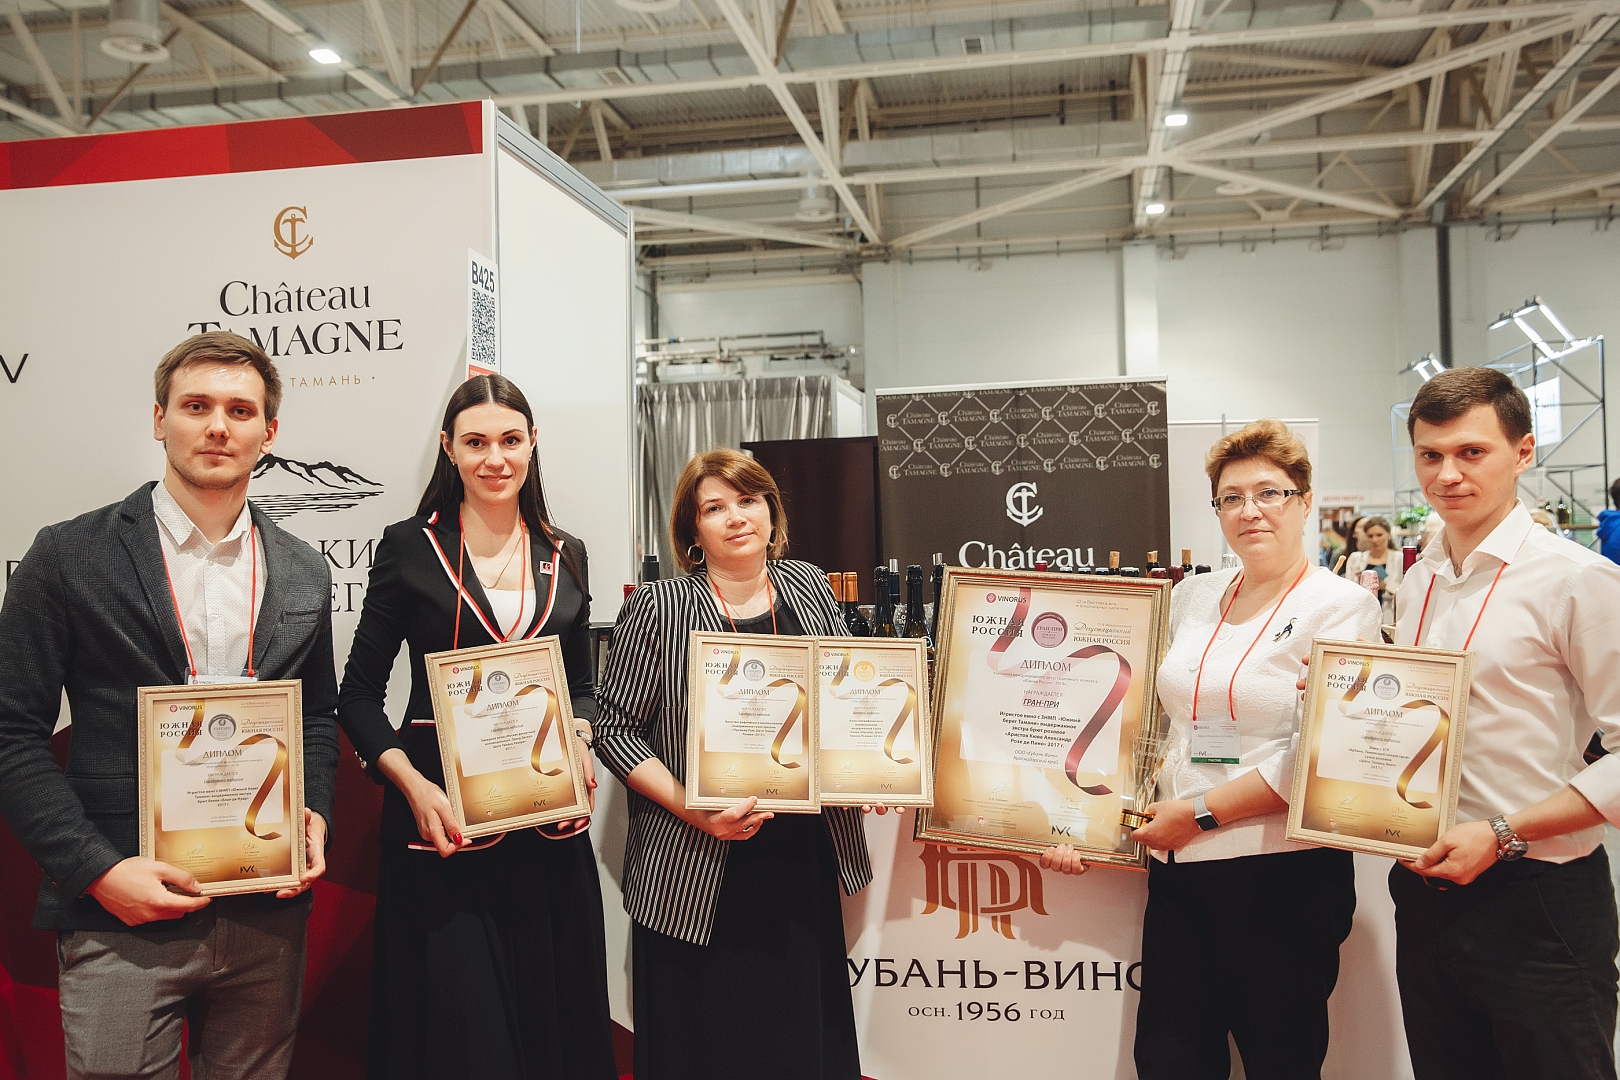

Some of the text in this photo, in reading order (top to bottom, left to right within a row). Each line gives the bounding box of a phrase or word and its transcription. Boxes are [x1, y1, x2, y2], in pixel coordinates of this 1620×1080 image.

[472, 260, 495, 294] B425
[219, 280, 371, 317] Château
[187, 318, 404, 357] TMAGNE
[290, 375, 361, 388] ТАМАНЬ
[1005, 412, 1039, 420] TAMAGNE
[1109, 407, 1145, 415] TAMAGNE
[928, 442, 962, 450] TAMAGNE
[958, 540, 1095, 569] Château
[997, 595, 1027, 604] VINORUS
[972, 615, 1025, 627] ЮЖНАЯ
[971, 626, 1023, 638] РОССИЯ
[1073, 636, 1131, 646] ЮЖНАЯ РОССИЯ
[1020, 659, 1071, 672] ДИПЛОМ
[1327, 673, 1368, 684] ЮЖНАЯ
[447, 679, 483, 690] ЮЖНАЯ
[1326, 681, 1367, 692] РОССИЯ
[448, 687, 484, 697] РОССИЯ
[738, 688, 770, 696] ДИПЛОМ
[1023, 689, 1063, 698] НАГРАЖДАЕТСЯ
[487, 699, 520, 711] ДИПЛОМ
[1023, 698, 1060, 708] ГРАН-ПРИ
[1363, 707, 1403, 718] ДИПЛОМ
[160, 721, 203, 730] ЮЖНАЯ
[160, 729, 202, 738] РОССИЯ
[202, 749, 242, 759] ДИПЛОМ
[955, 1001, 1021, 1022] 1956
